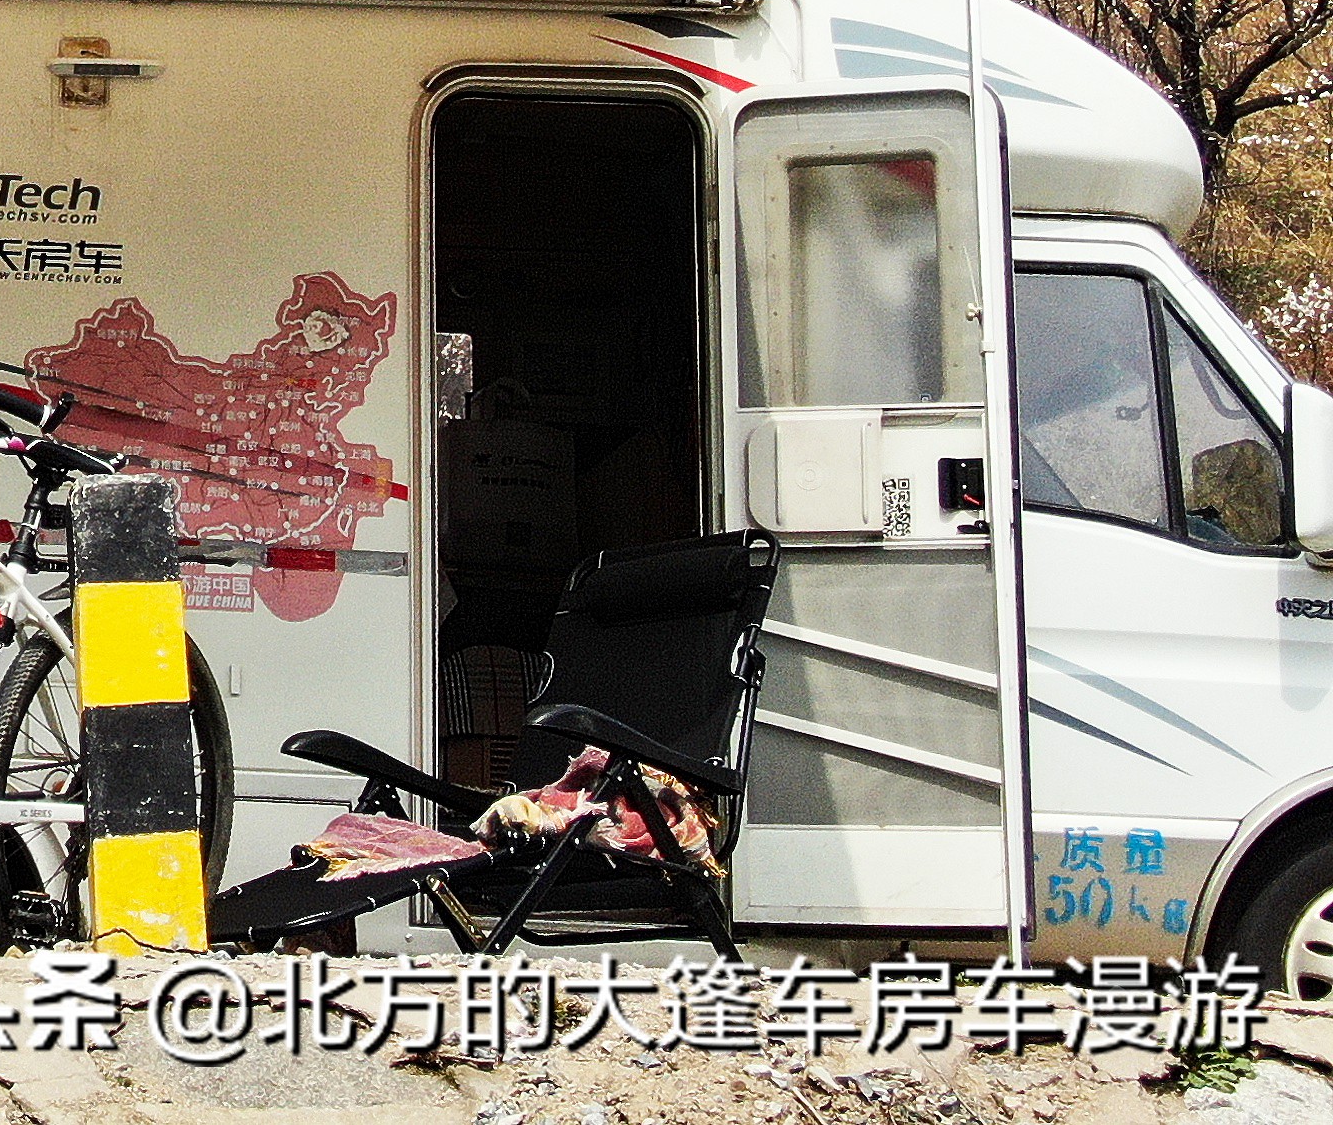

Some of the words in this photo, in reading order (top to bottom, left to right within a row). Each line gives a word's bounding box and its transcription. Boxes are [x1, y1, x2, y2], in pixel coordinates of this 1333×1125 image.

[186, 595, 211, 607] OVE
[213, 595, 252, 609] CHINA
[1061, 826, 1166, 875] 质量
